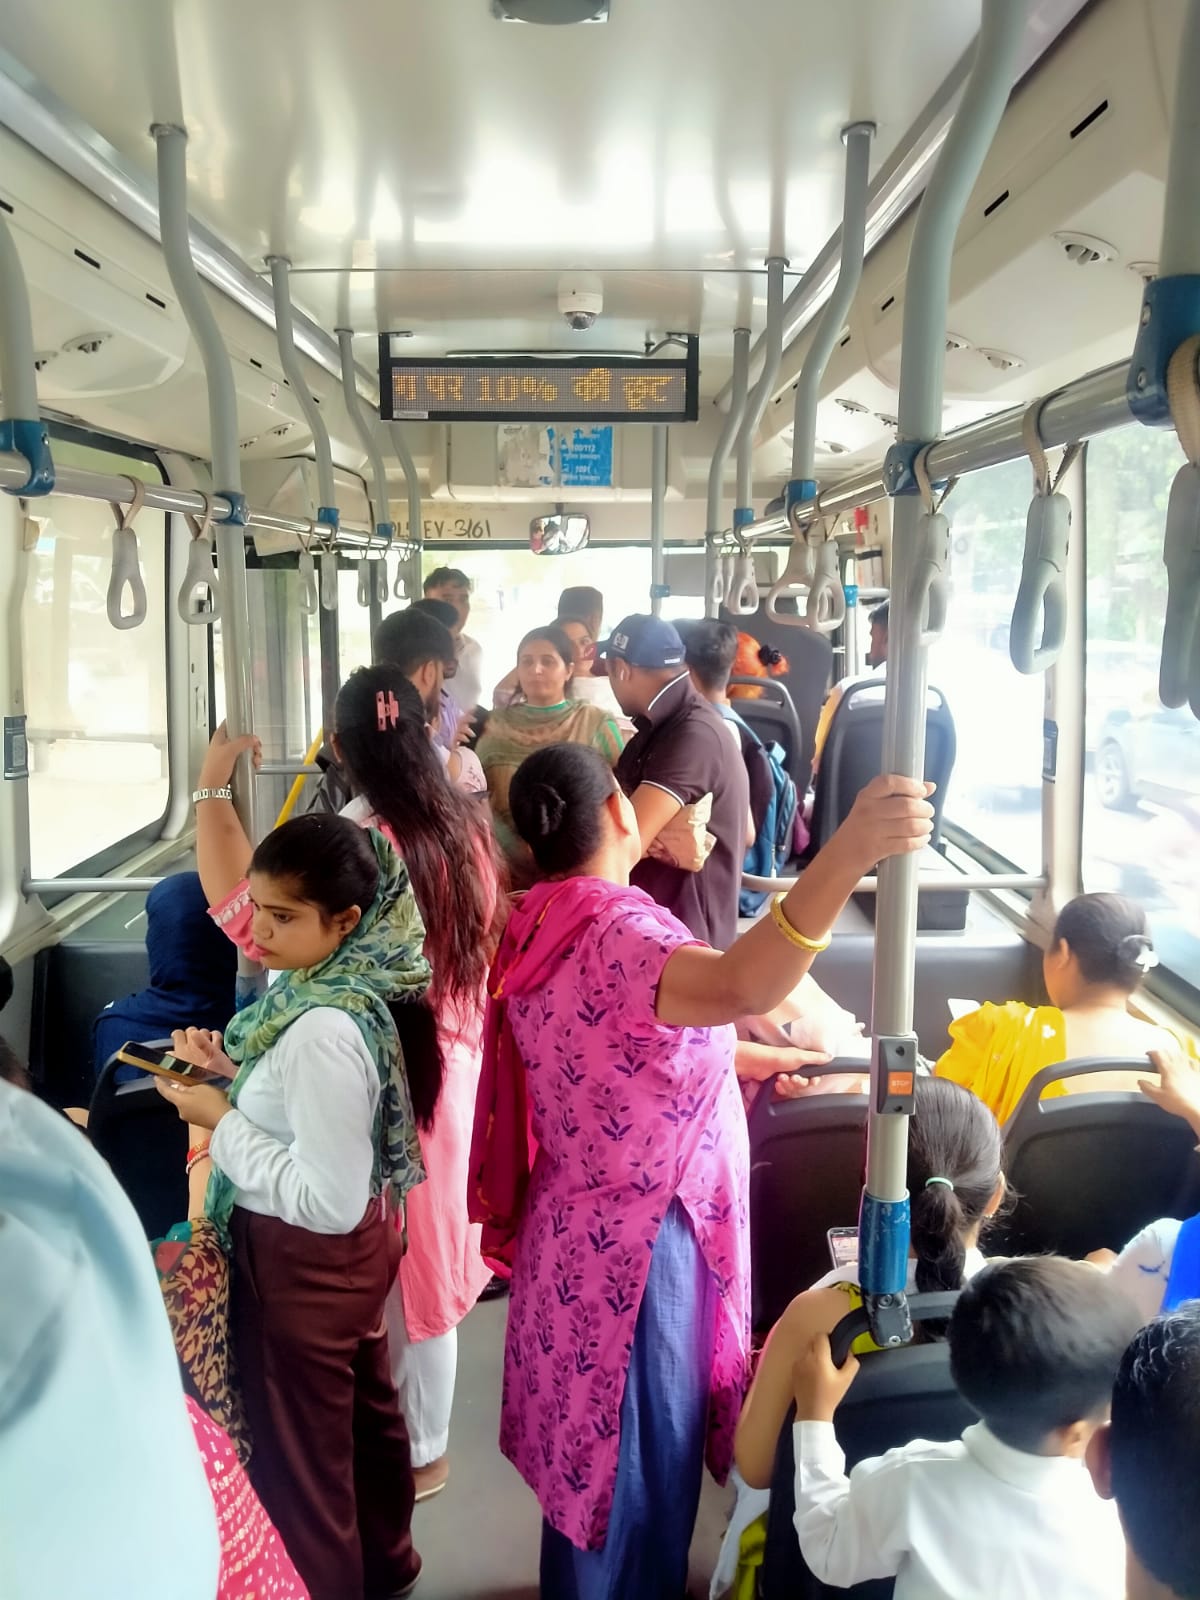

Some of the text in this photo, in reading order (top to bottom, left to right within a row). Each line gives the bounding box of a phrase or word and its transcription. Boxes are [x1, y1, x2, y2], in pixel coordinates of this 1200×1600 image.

[424, 375, 466, 400] पर
[476, 375, 558, 400] 10%
[570, 368, 611, 401] की
